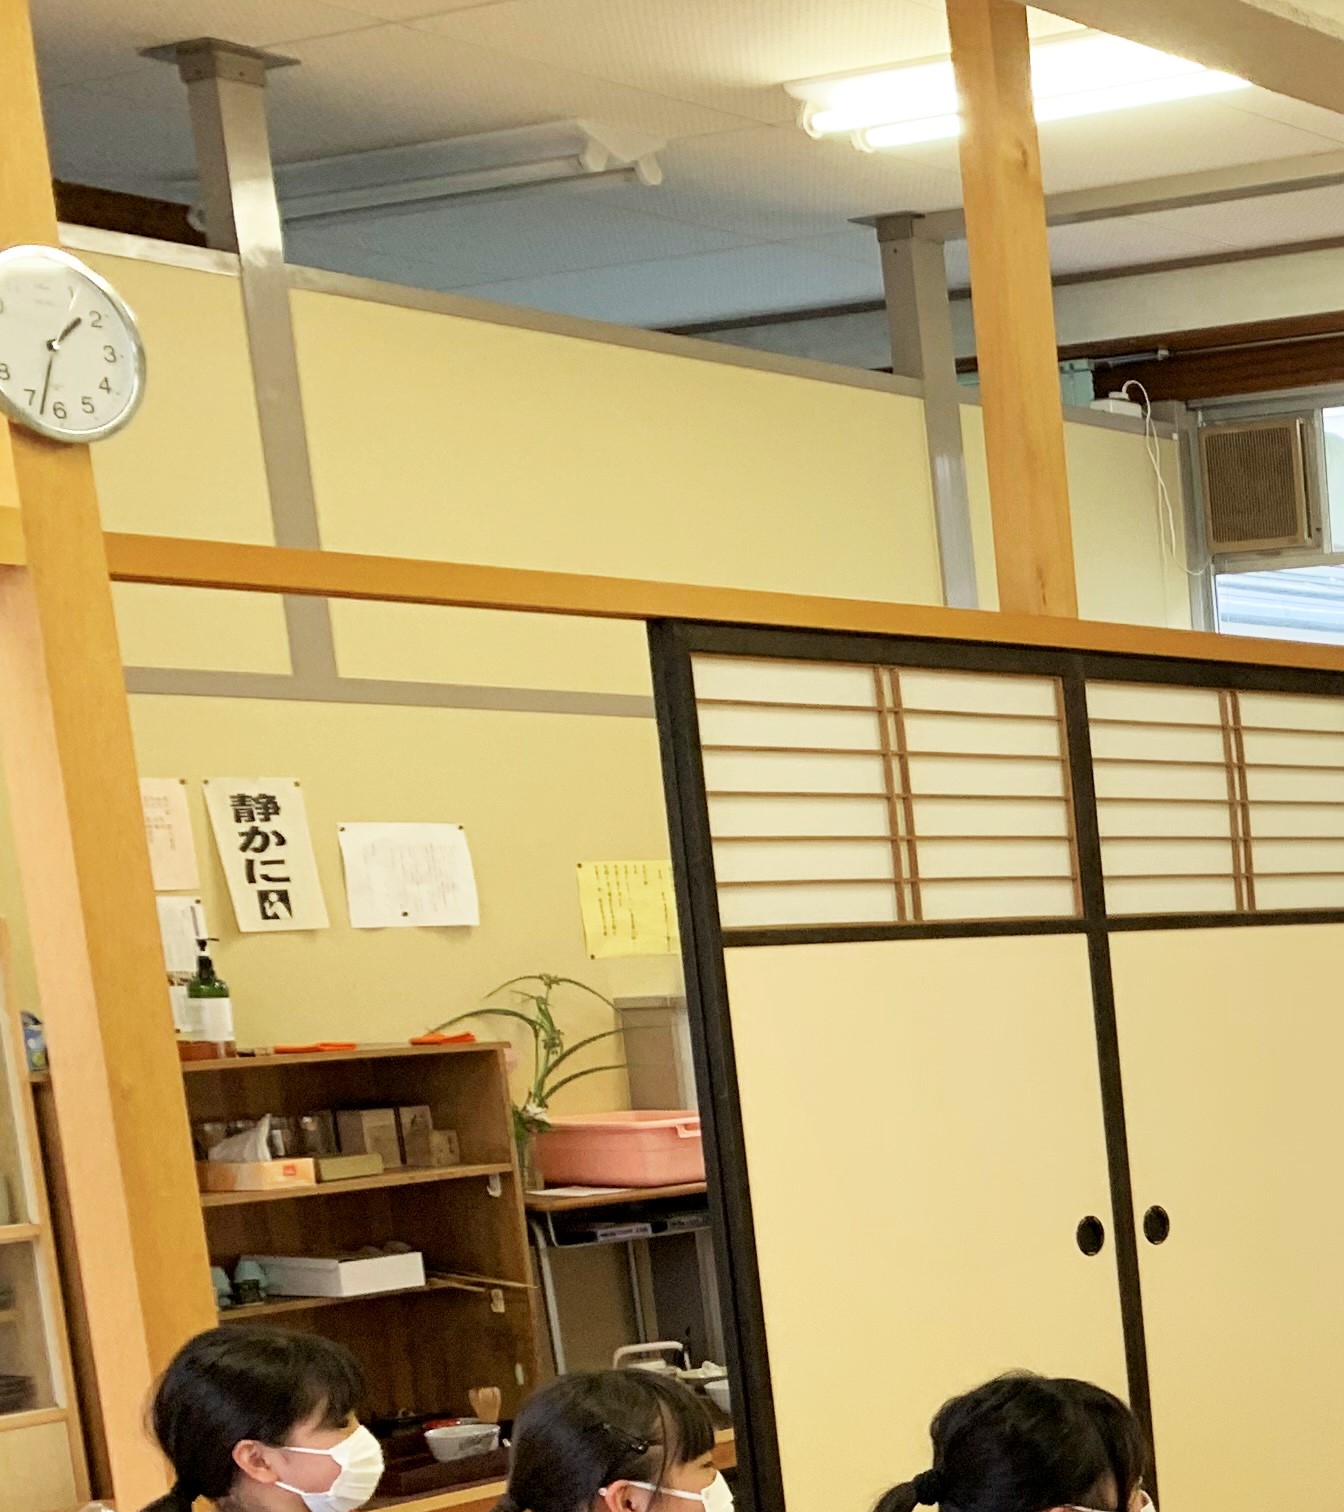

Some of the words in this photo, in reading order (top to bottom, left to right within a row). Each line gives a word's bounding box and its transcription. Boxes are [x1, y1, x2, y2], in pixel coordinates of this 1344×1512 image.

[88, 310, 103, 328] 2
[103, 345, 117, 363] 3
[98, 376, 112, 394] 4
[23, 388, 36, 406] 7
[81, 396, 96, 414] 5
[52, 401, 67, 419] 6
[229, 793, 292, 885] 静かに
